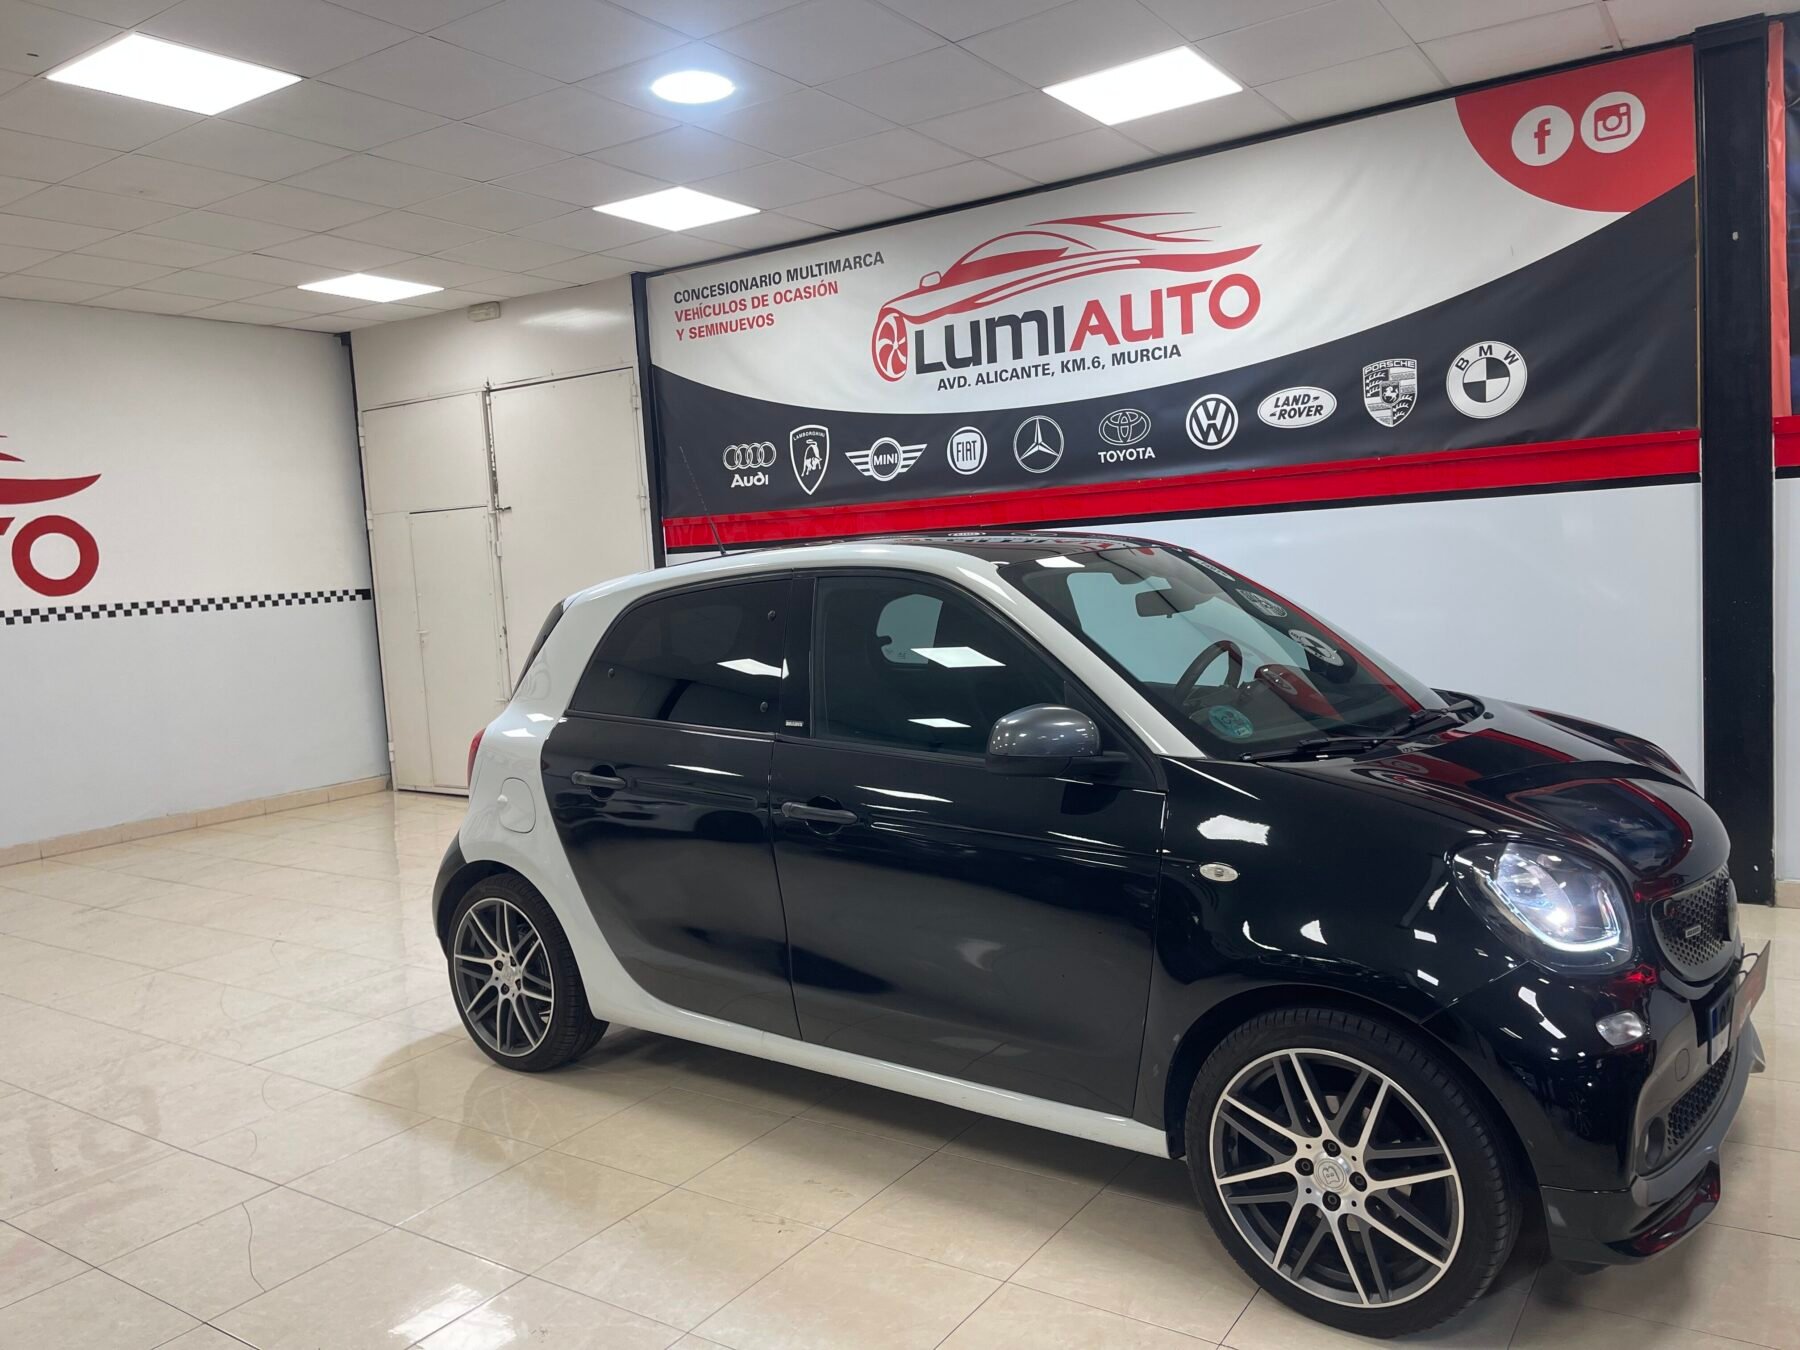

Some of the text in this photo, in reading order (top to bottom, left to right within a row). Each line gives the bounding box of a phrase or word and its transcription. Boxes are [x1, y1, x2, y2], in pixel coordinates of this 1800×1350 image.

[674, 251, 885, 304] CONCESIONARIO MULTIMARCA
[675, 280, 839, 322] VEHÍCULOS DE OCASIÓN
[676, 313, 775, 341] Y SEMINUEVOS
[937, 344, 1181, 392] AVD. ALICANTE, KM.6, MURCIA
[1364, 359, 1416, 375] PORSCHE
[1455, 344, 1519, 372] BMW
[873, 453, 898, 466] MINI
[956, 440, 977, 462] FIAT
[1098, 447, 1156, 464] TOYOTA
[730, 471, 769, 488] Audi
[0, 515, 100, 597] O
